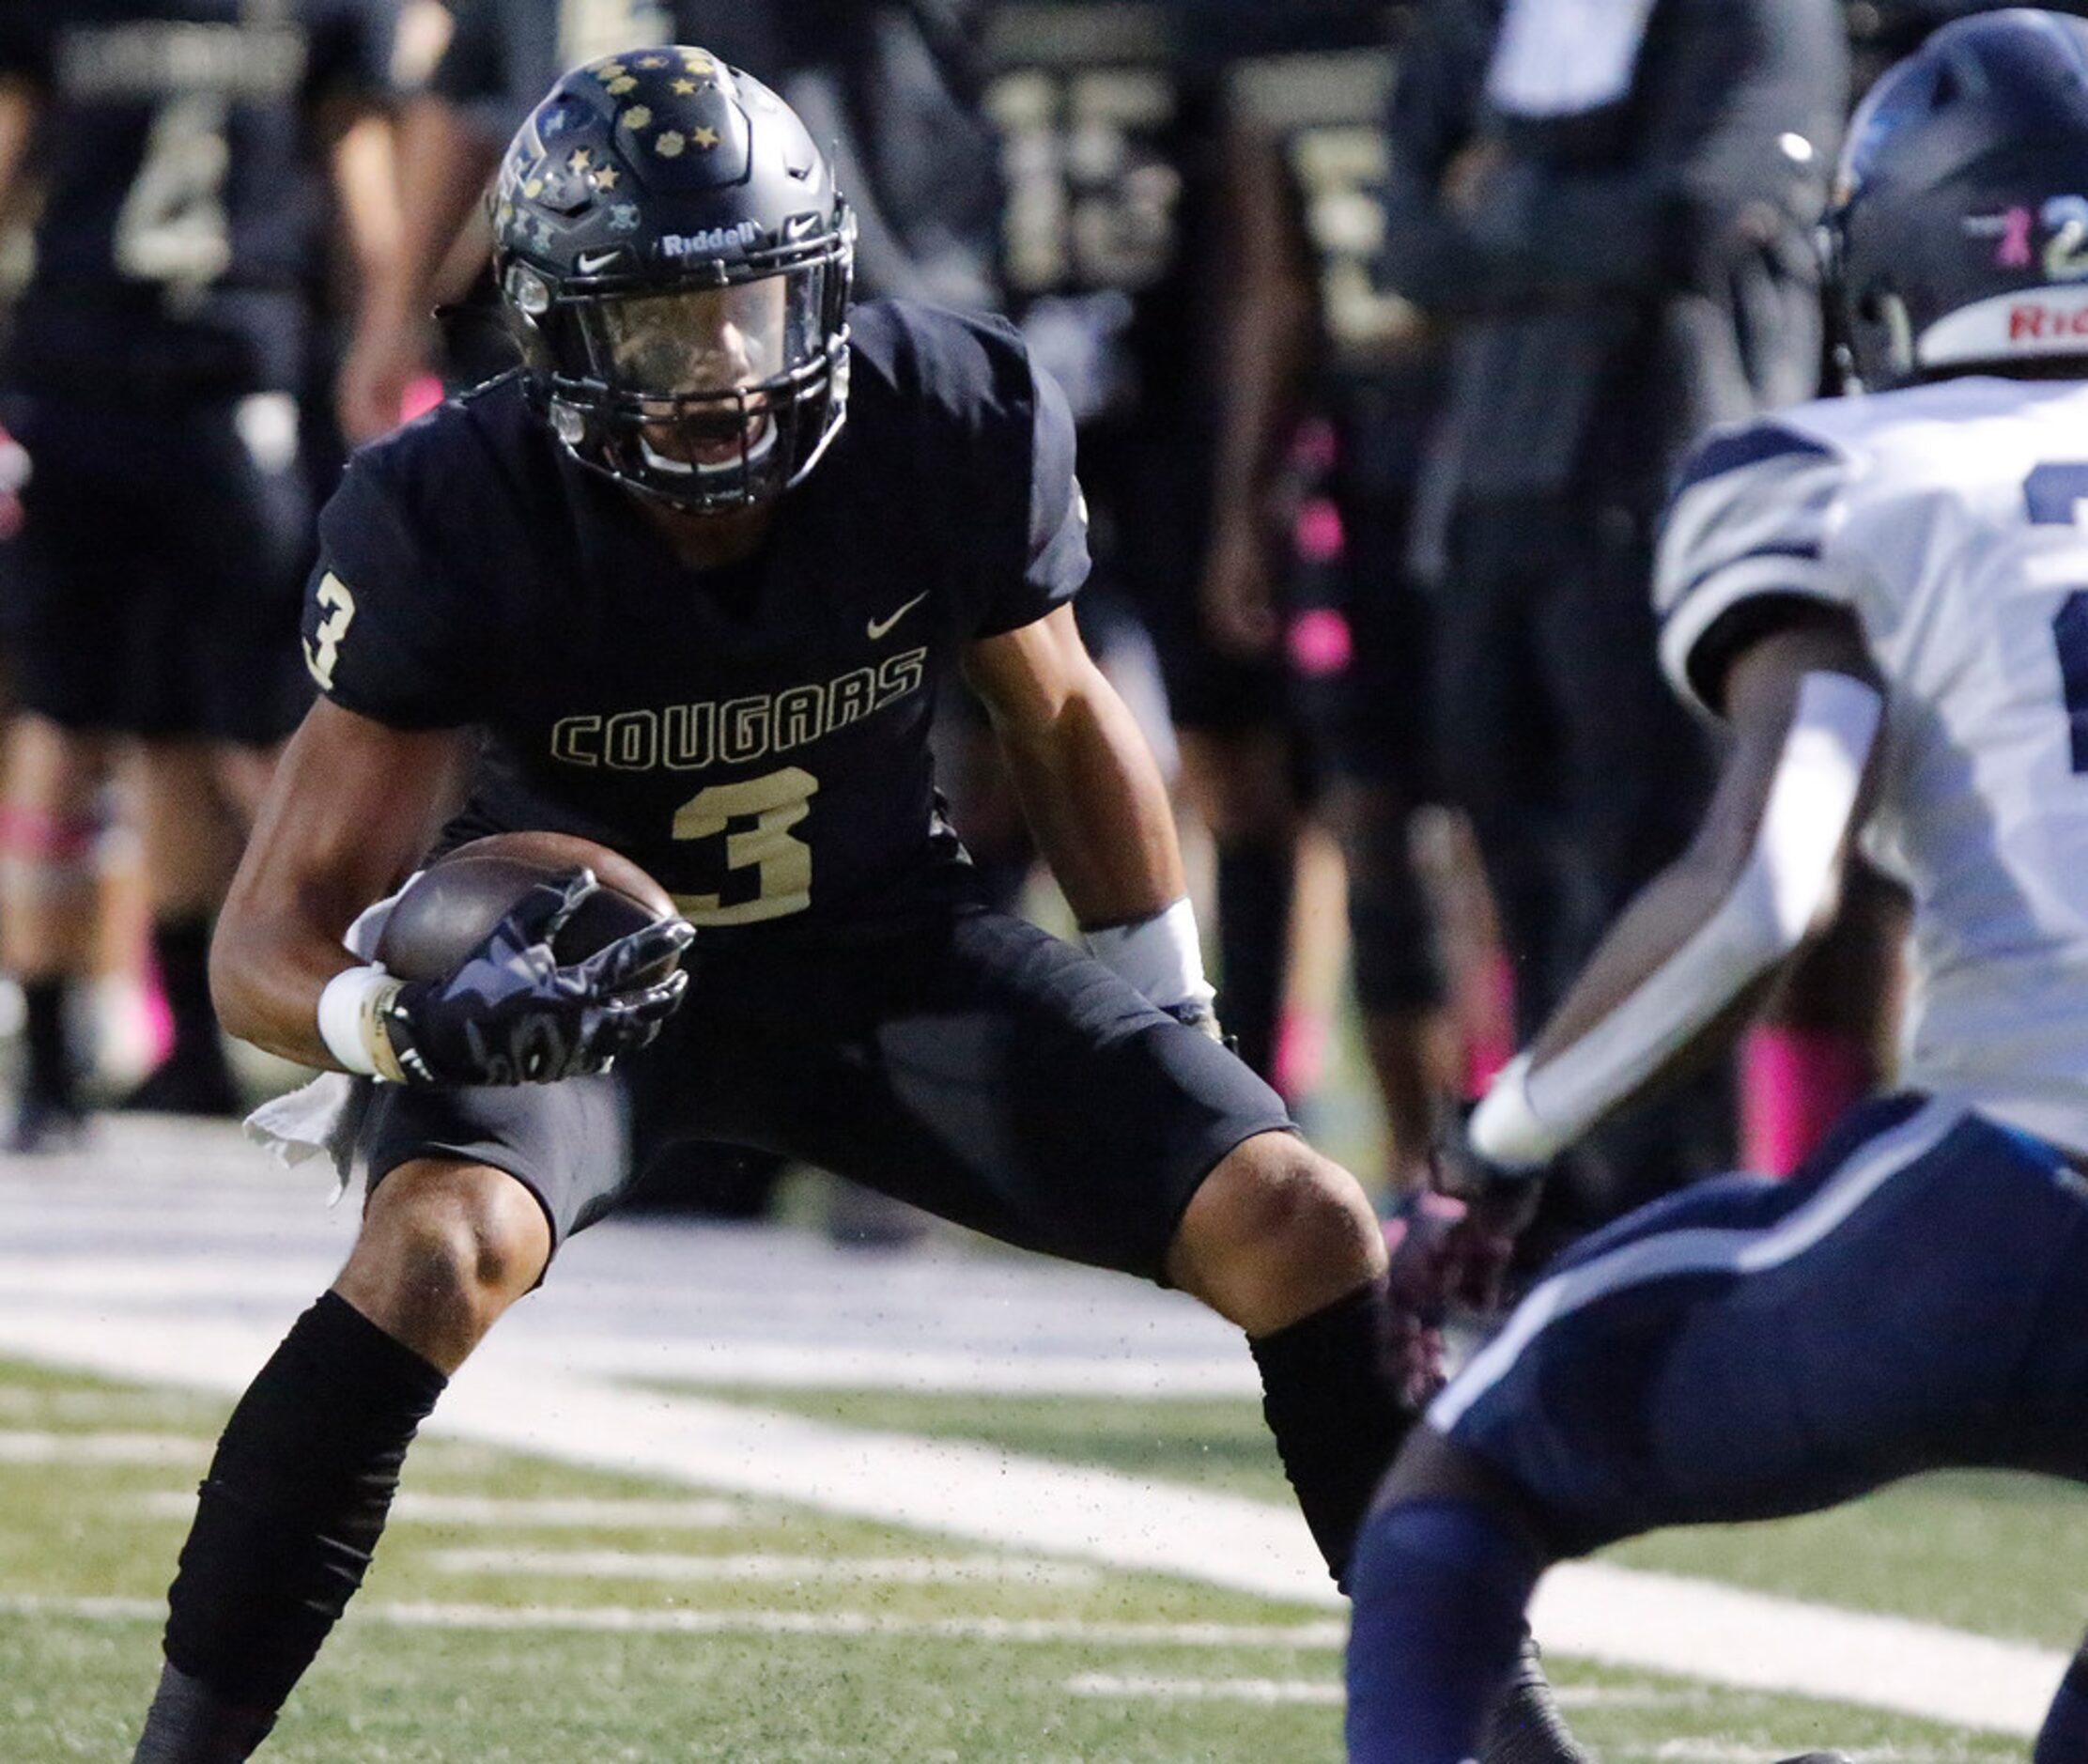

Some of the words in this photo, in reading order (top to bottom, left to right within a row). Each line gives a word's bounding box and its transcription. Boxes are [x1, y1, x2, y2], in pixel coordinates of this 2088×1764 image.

[661, 221, 755, 256] Riddell
[302, 570, 356, 691] 3
[551, 646, 928, 770] COUGARS
[671, 766, 820, 926] 3
